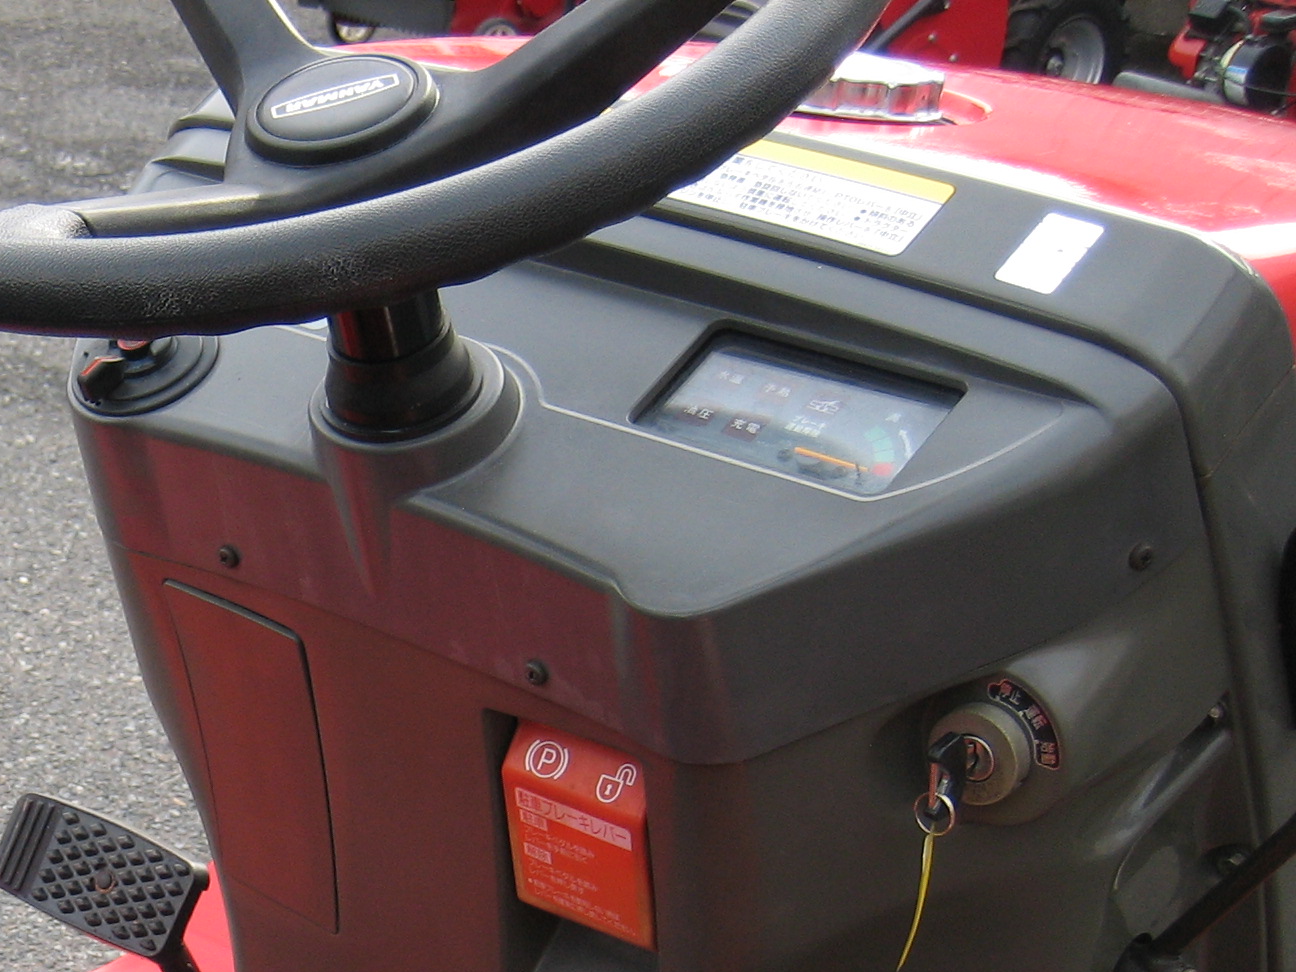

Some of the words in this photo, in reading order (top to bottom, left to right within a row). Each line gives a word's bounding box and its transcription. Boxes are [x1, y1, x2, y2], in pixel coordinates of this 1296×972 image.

[285, 77, 385, 113] YANMAR
[684, 405, 714, 420] 油圧
[730, 418, 761, 434] 充電
[517, 790, 628, 844] 駐車ブレーキレバー
